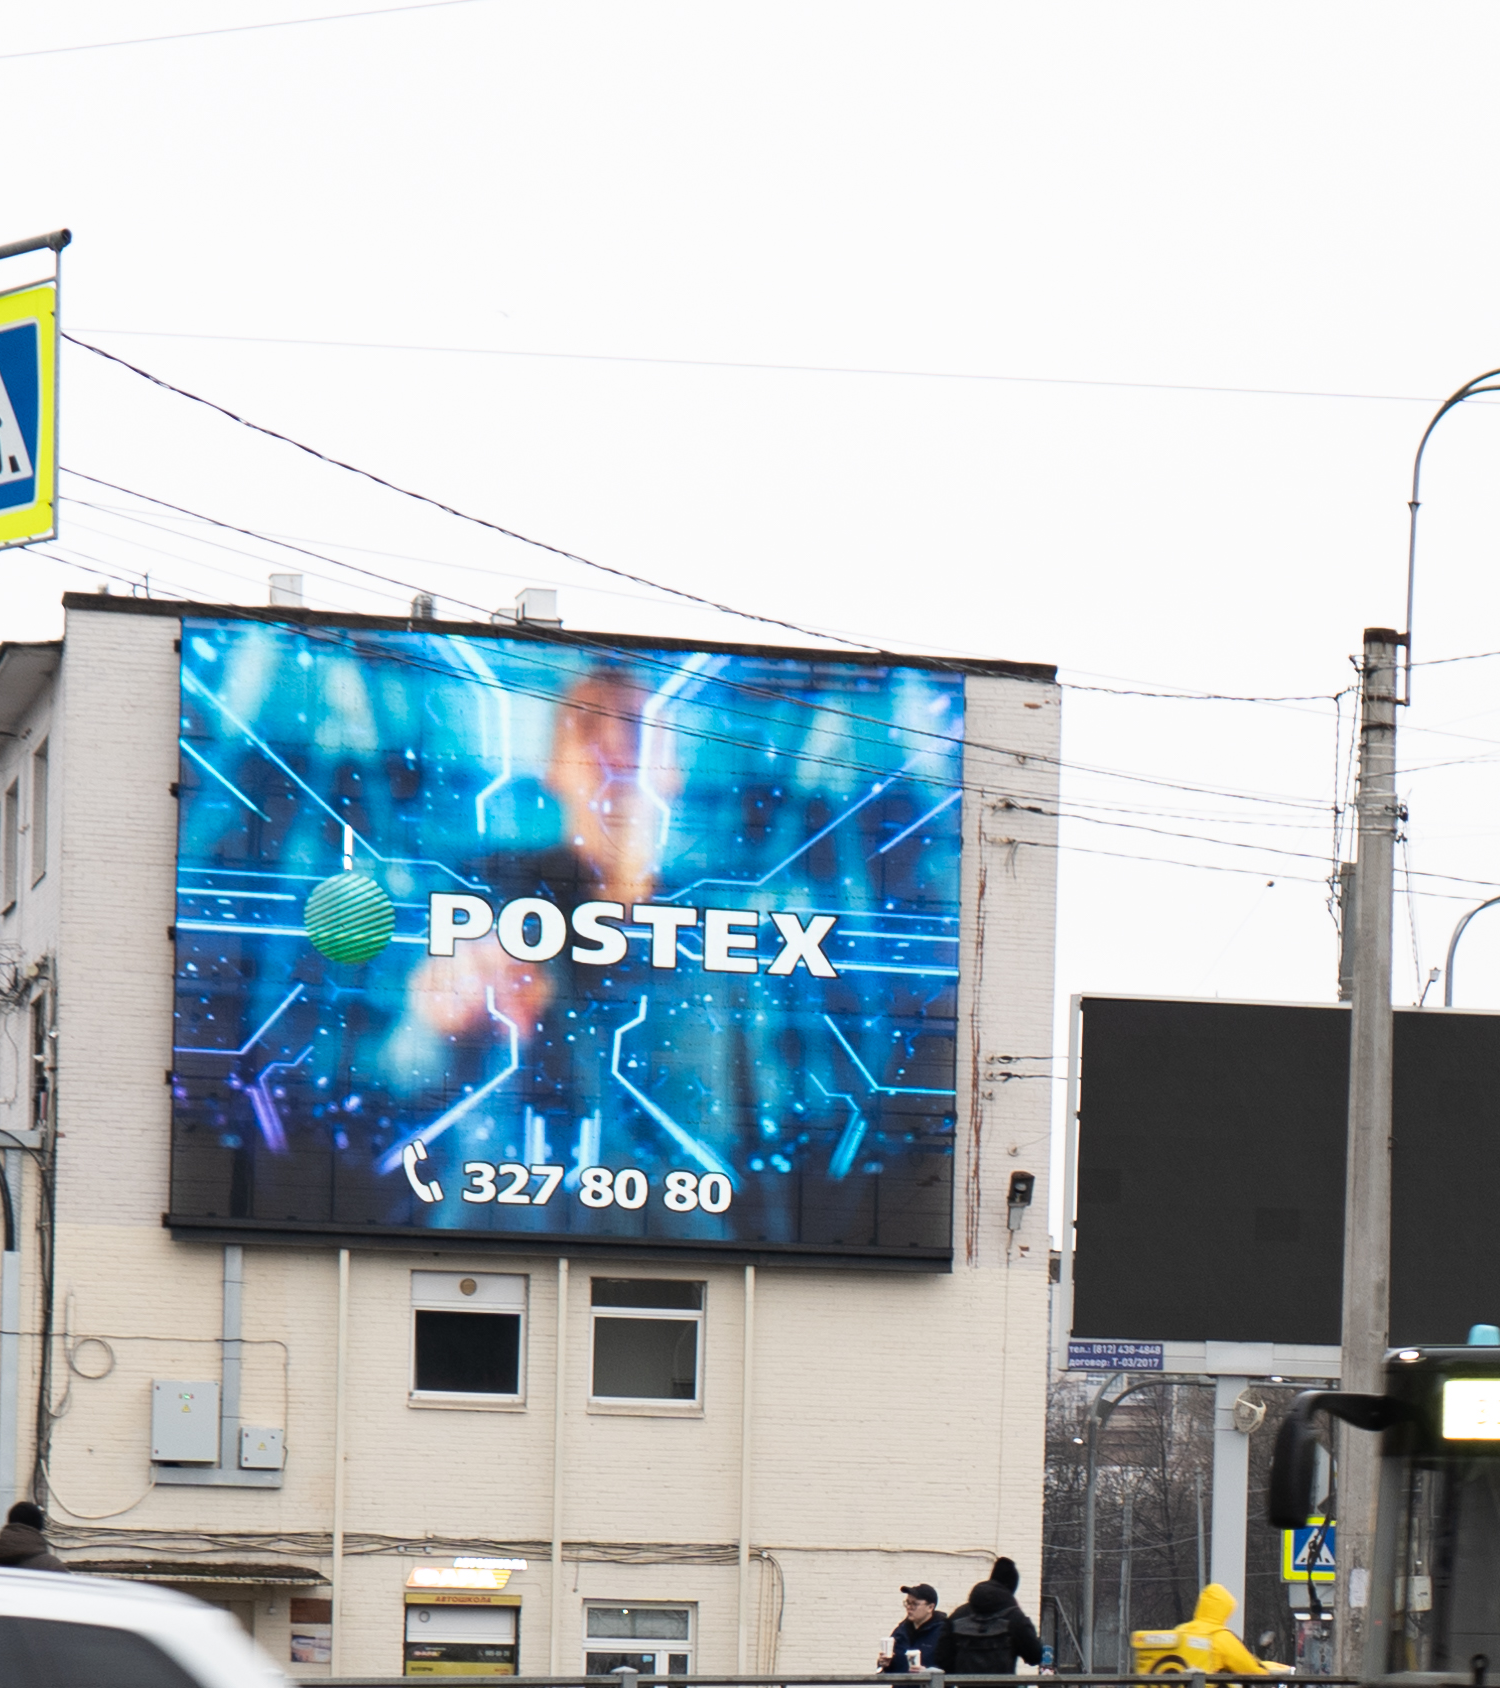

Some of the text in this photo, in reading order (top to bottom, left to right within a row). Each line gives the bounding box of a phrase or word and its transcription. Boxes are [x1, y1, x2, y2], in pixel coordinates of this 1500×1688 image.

[428, 891, 840, 979] POSTEX
[462, 1160, 733, 1214] 327 80 80
[1068, 1358, 1111, 1368] договор:
[1092, 1344, 1116, 1355] (812)
